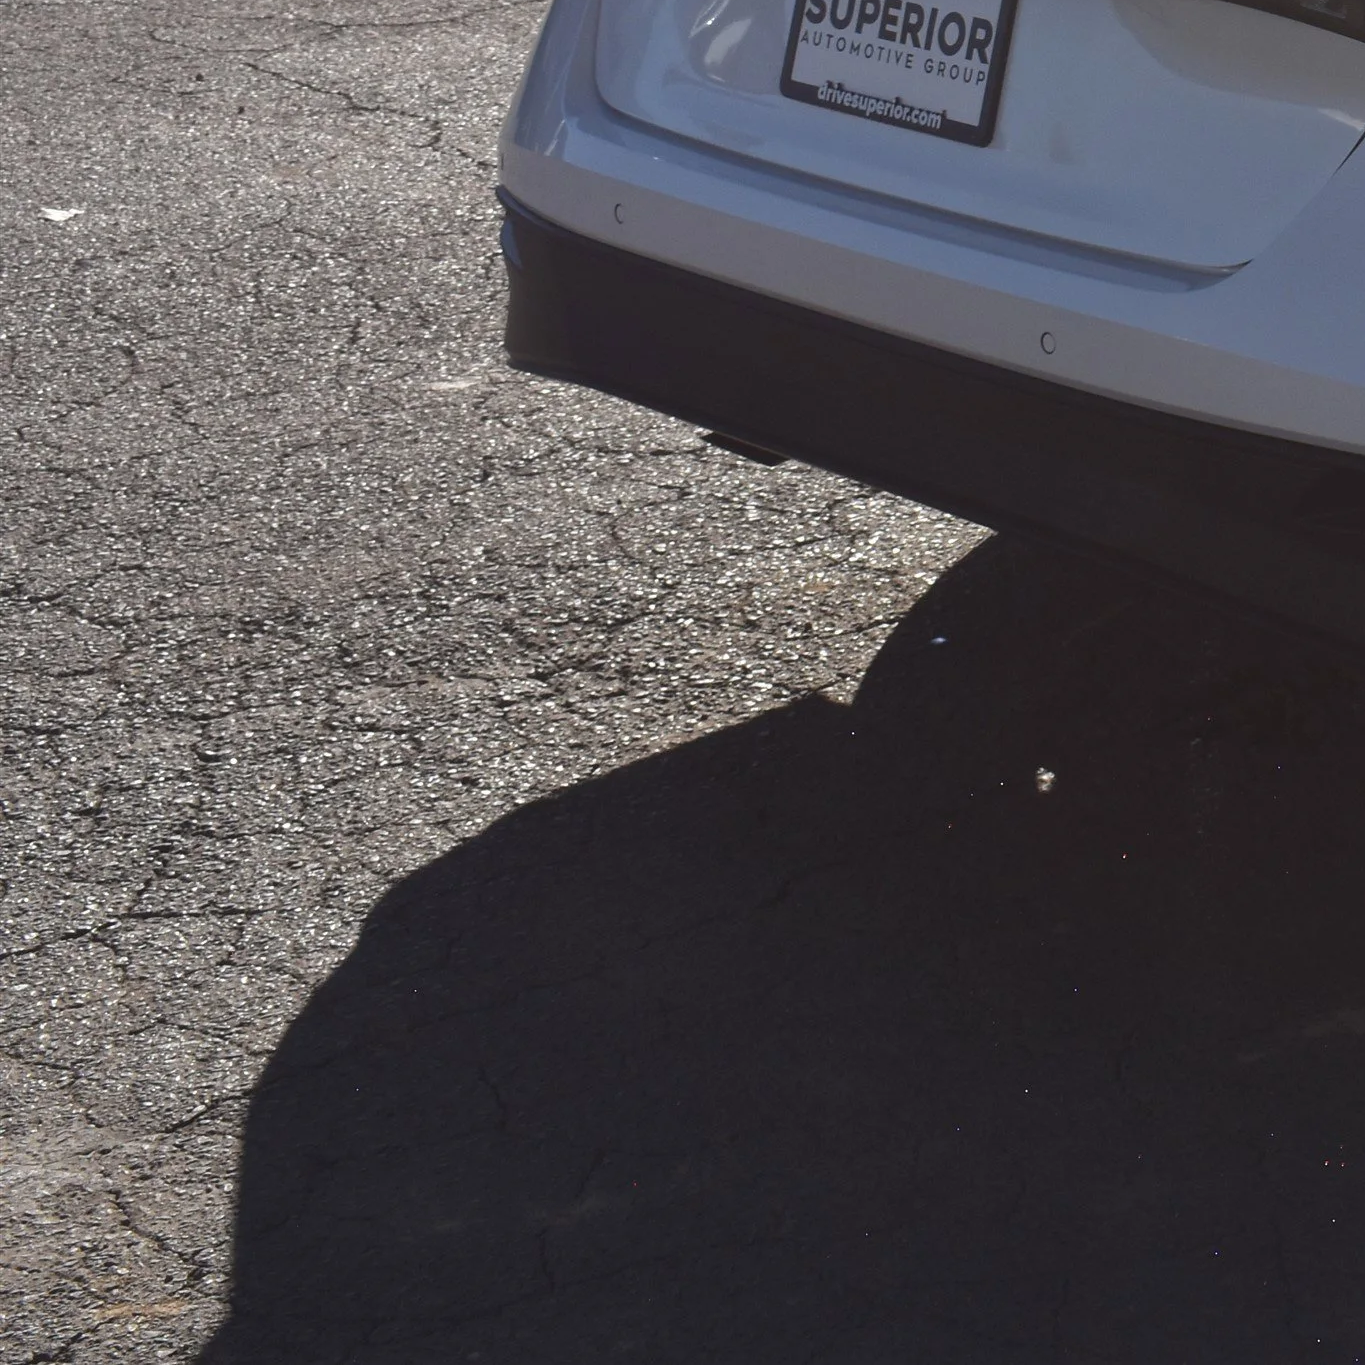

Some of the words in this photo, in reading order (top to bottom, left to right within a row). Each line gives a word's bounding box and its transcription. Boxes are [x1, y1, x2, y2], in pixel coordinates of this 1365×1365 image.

[800, 29, 914, 70] AUTOMOTIVE
[923, 57, 986, 86] GROUP
[817, 83, 943, 130] drivesuperior.com
